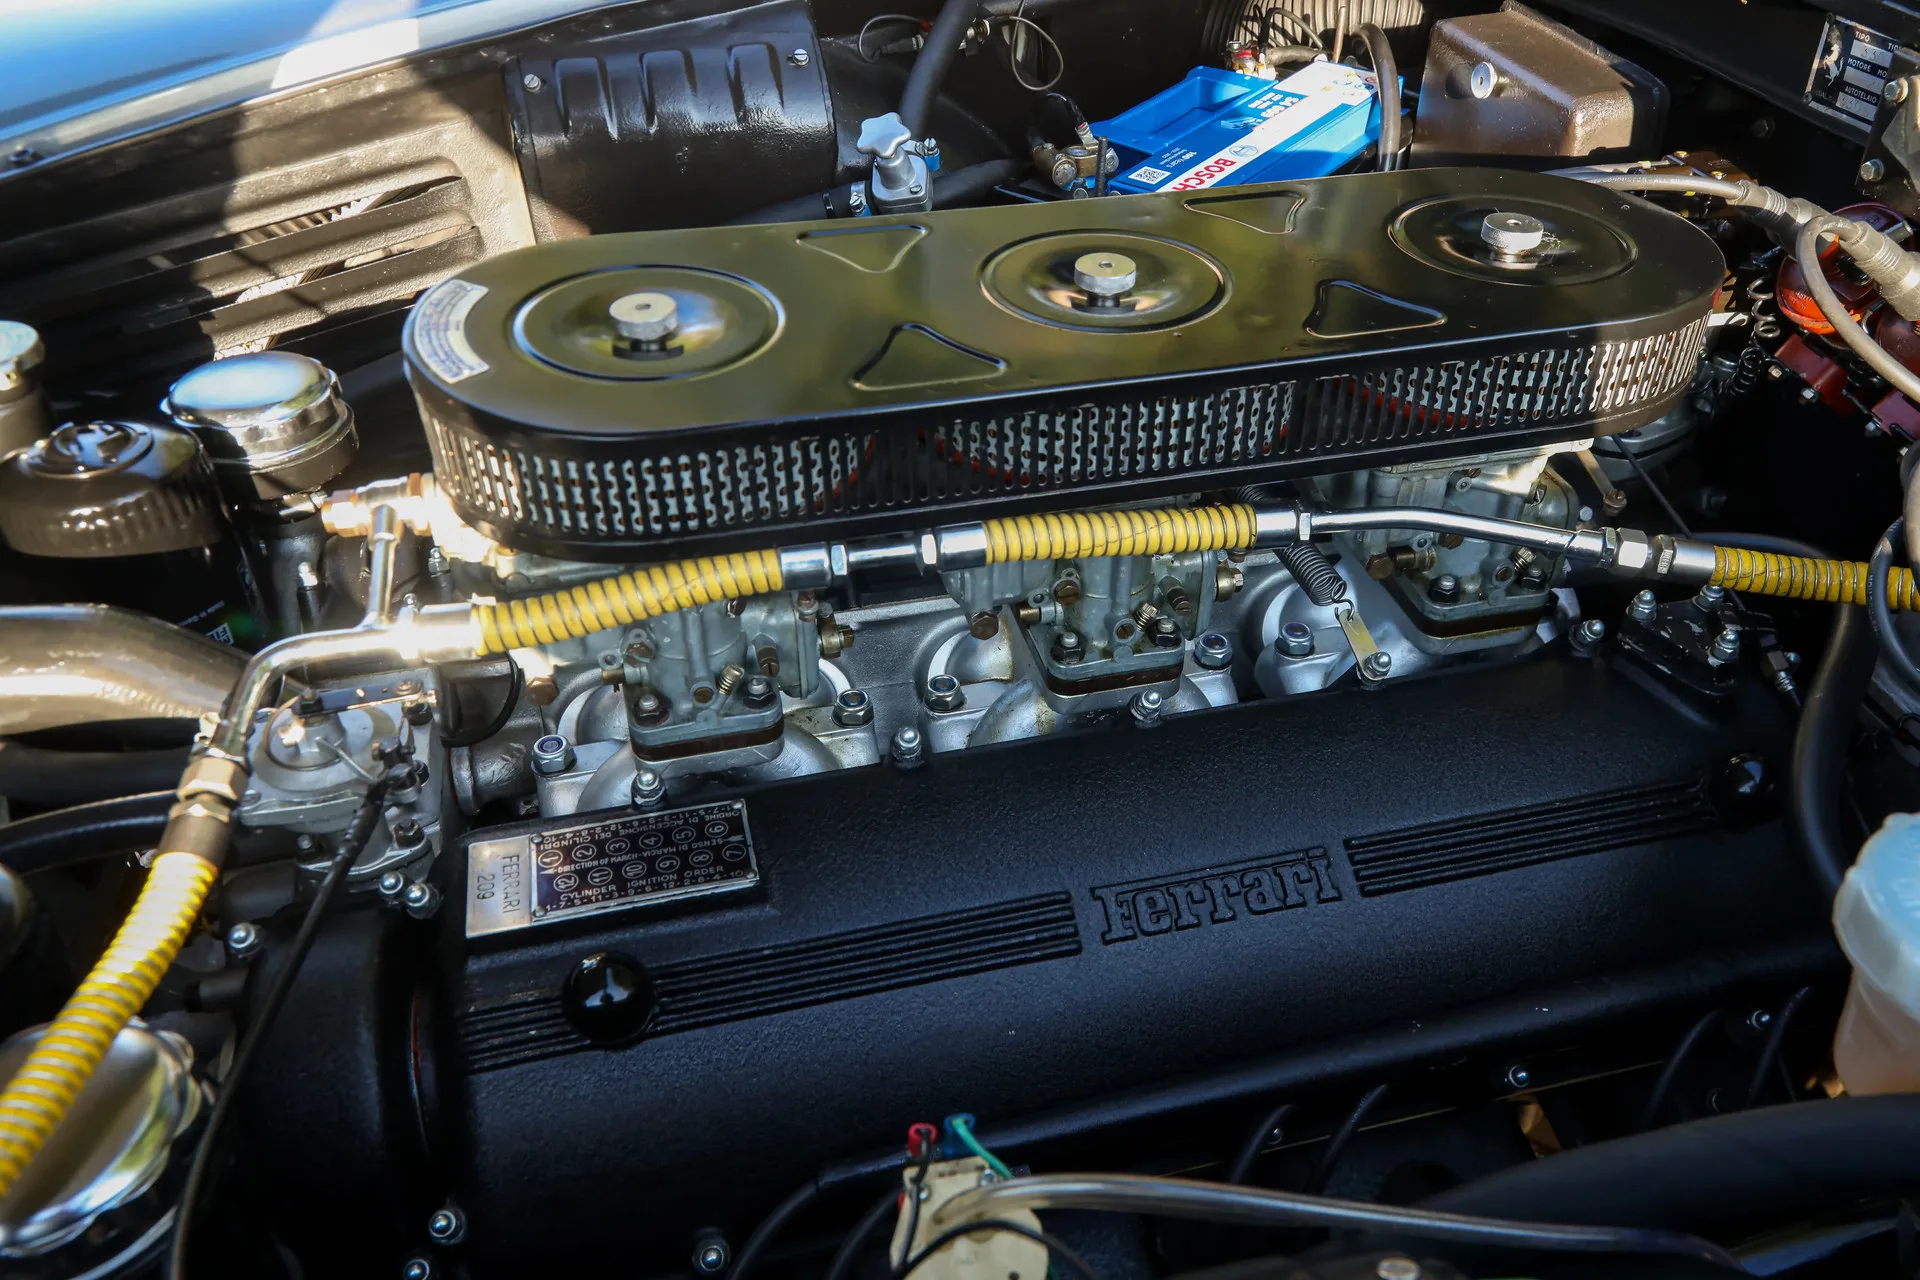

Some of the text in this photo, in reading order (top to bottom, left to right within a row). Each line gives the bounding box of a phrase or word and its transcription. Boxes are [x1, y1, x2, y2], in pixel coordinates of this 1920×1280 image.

[1855, 31, 1871, 42] TIPO
[1887, 42, 1902, 51] TIP
[1847, 57, 1872, 72] MOTORE
[1844, 85, 1878, 104] AUTOTELAIO
[1172, 158, 1237, 192] BOSCH
[704, 811, 740, 821] ORDINE
[540, 836, 591, 850] CILINDRI
[595, 832, 612, 841] DEI
[691, 838, 724, 849] SENSO
[557, 860, 599, 873] DIRECTION
[599, 858, 609, 866] OF
[476, 873, 495, 900] 209
[502, 855, 520, 914] FERRARI
[560, 865, 725, 901] CYLINDER IGNITION ORDER
[1090, 846, 1342, 945] Ferrari
